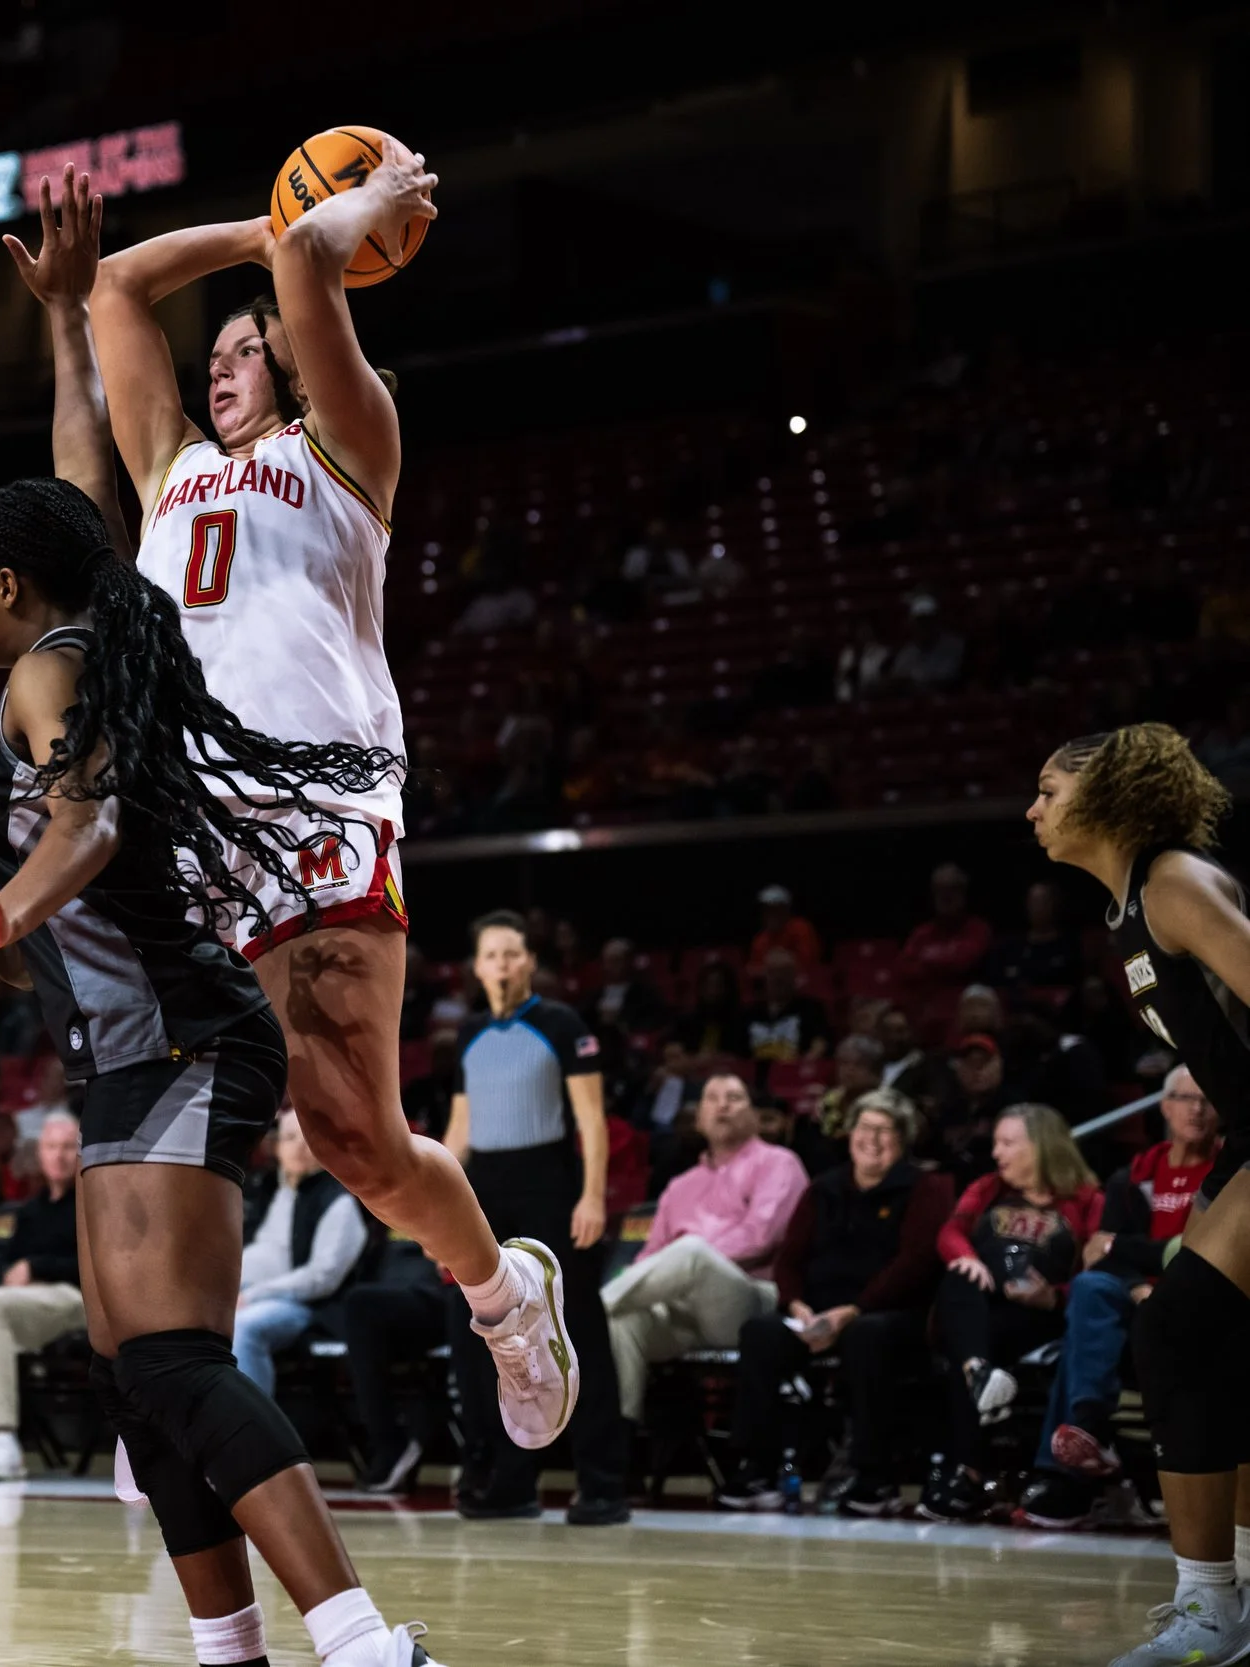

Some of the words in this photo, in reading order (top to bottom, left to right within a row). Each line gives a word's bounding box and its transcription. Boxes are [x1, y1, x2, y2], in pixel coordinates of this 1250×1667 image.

[288, 164, 317, 212] son
[152, 459, 305, 533] MARYLAND
[183, 508, 237, 608] 0
[297, 836, 348, 887] M
